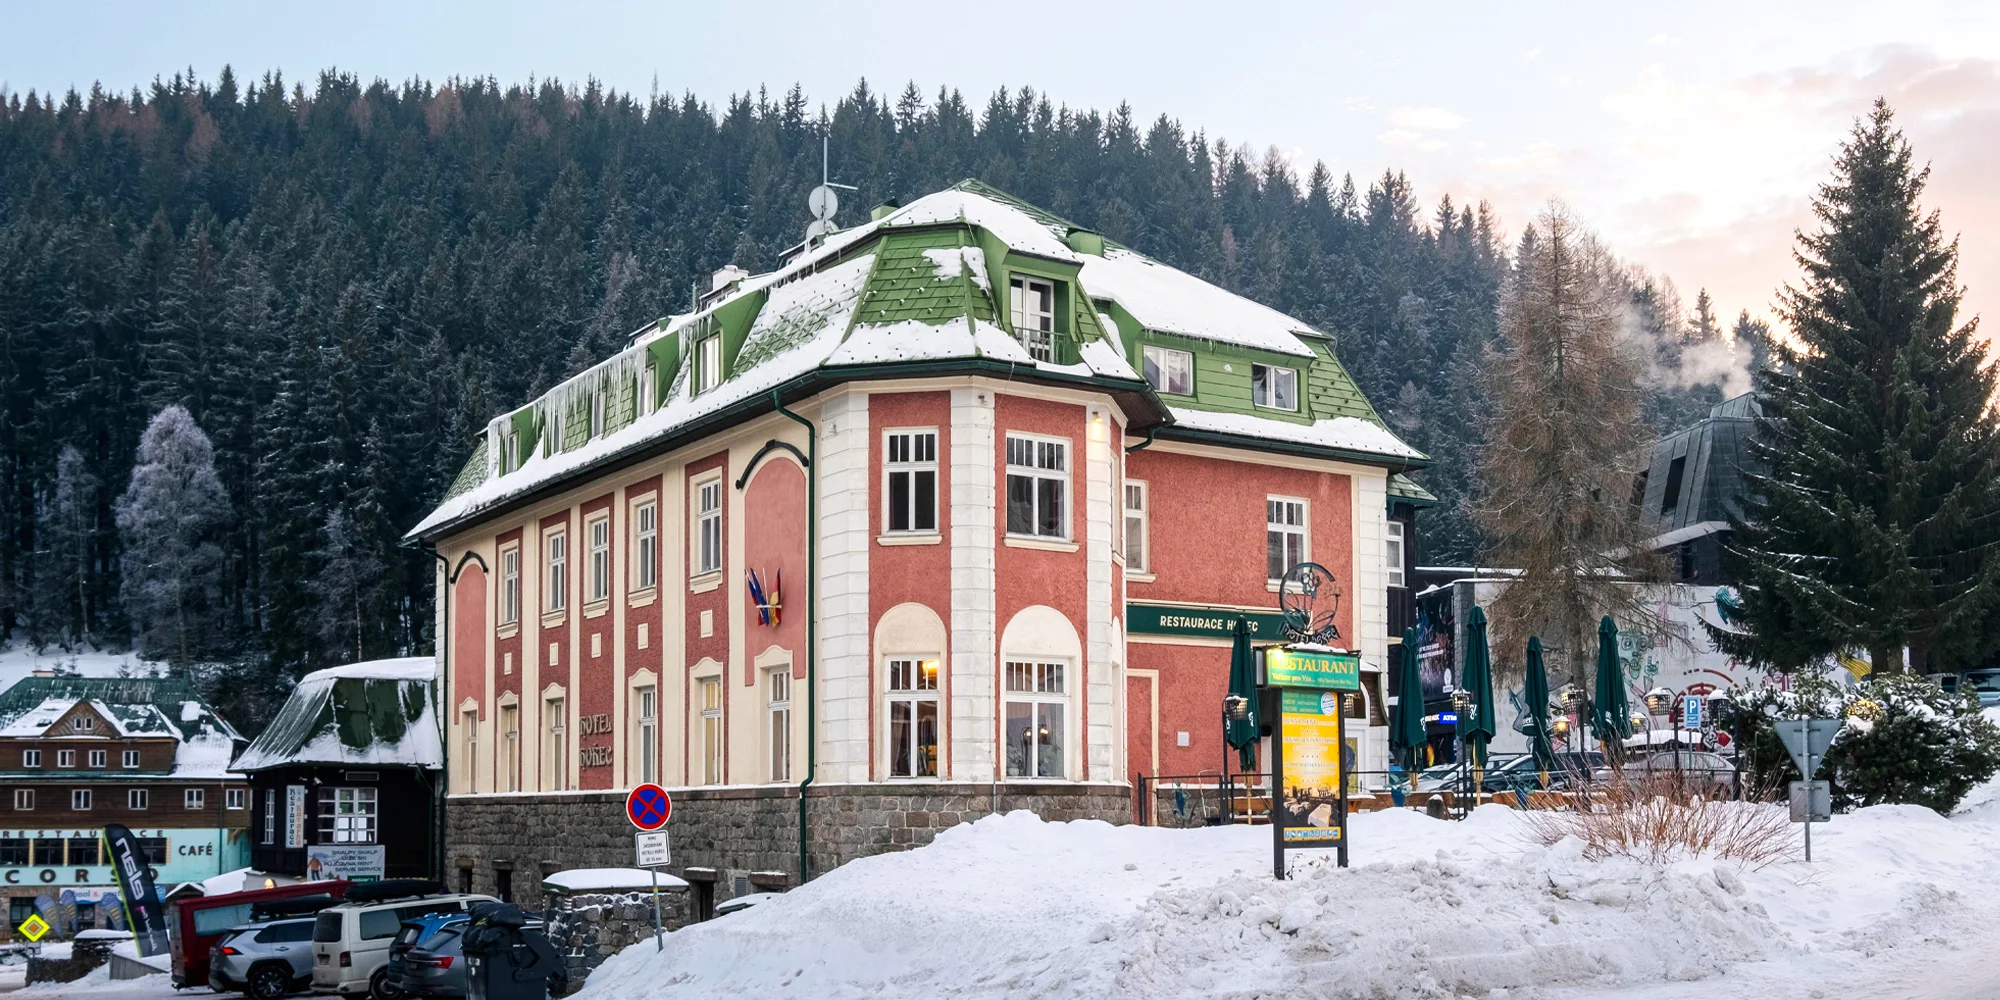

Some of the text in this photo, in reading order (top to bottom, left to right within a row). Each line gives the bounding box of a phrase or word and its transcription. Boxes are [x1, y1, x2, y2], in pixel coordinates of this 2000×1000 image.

[1160, 615, 1259, 633] RESTAURACE HEC
[1690, 700, 1697, 713] P
[579, 713, 612, 738] HOTEL
[2, 829, 165, 838] RESTAUCE
[178, 842, 214, 857] CAFÉ
